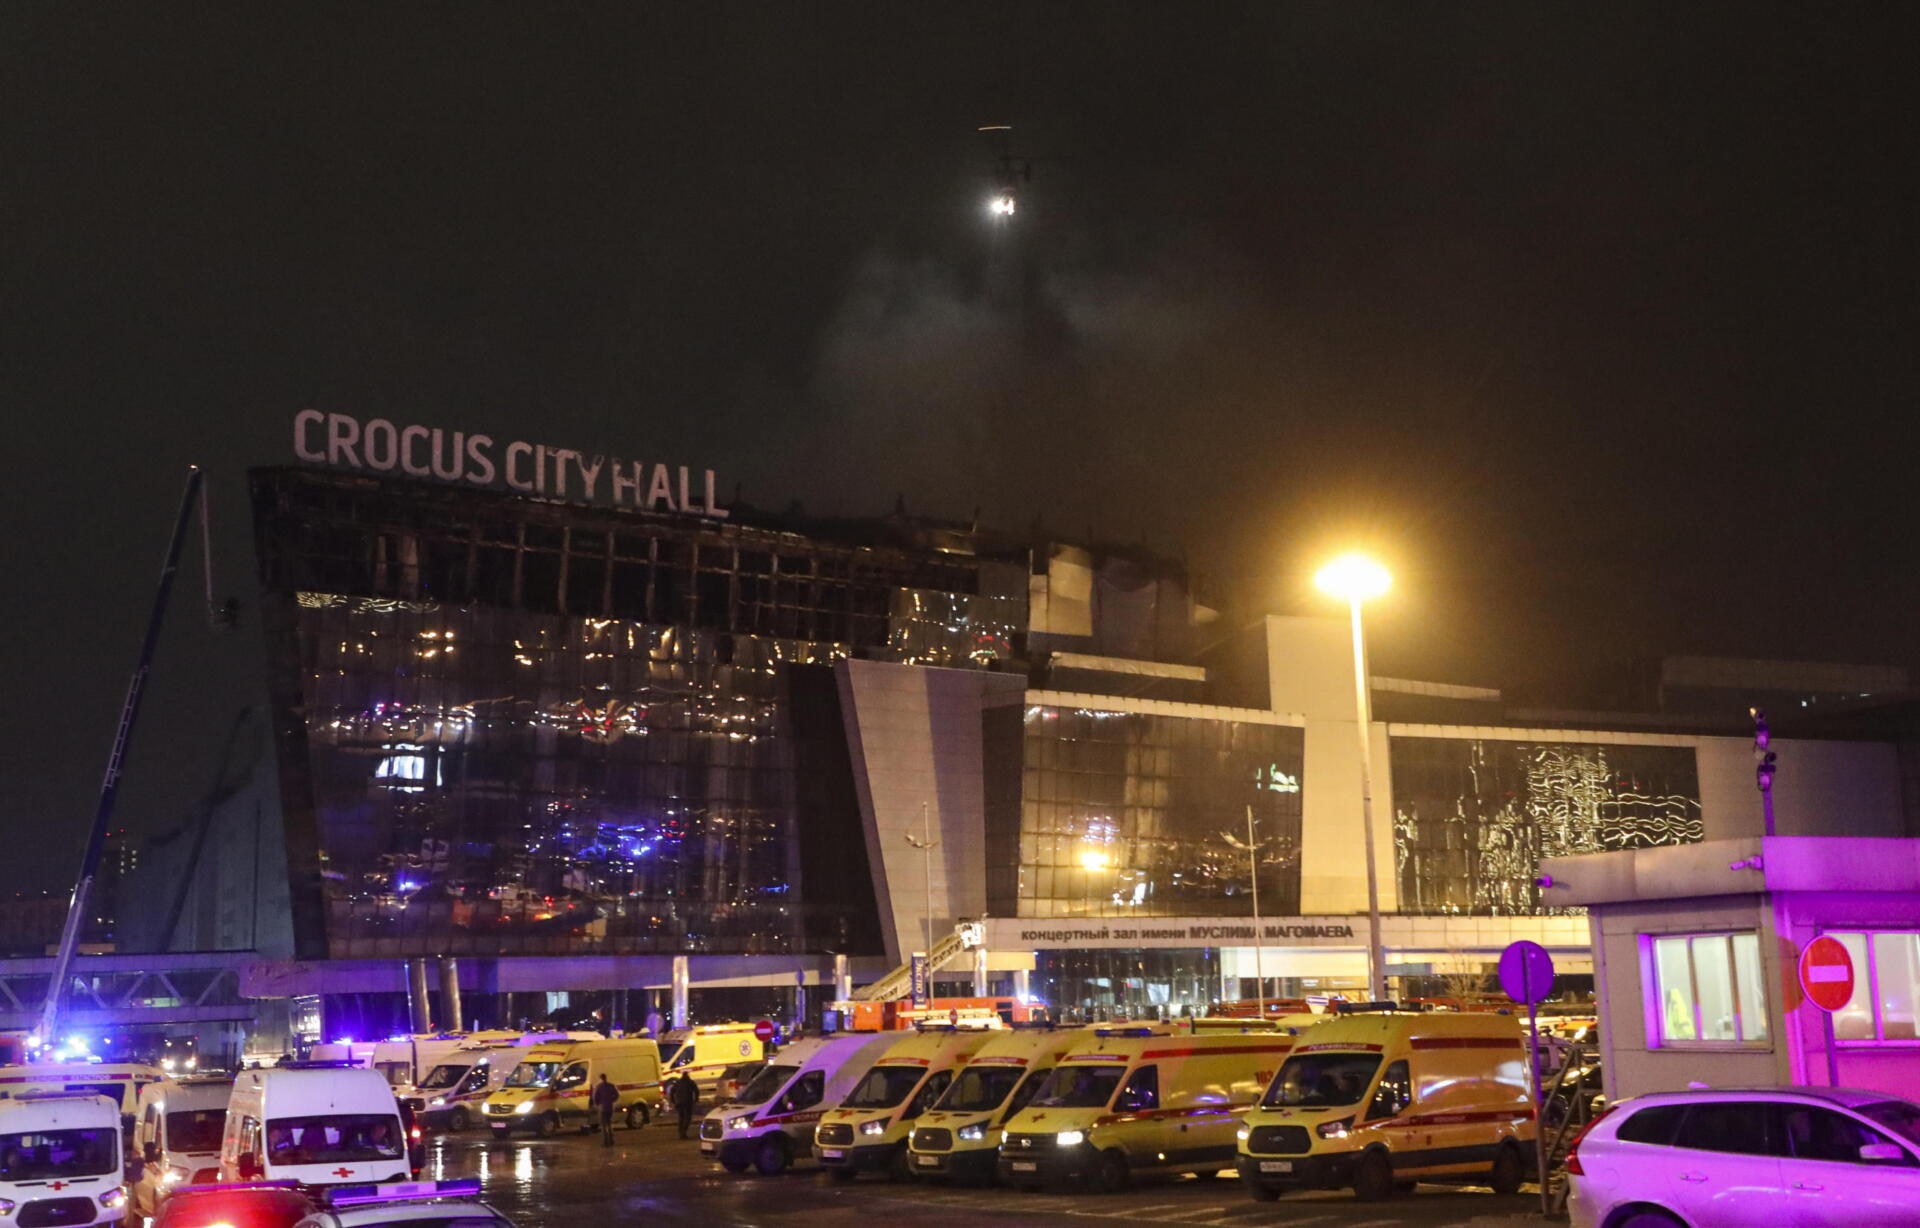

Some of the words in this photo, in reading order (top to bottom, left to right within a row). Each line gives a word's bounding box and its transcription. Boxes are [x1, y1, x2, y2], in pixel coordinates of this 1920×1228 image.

[294, 408, 496, 484] CROCUS
[505, 441, 604, 499] CITY
[612, 457, 730, 518] HALL
[1021, 926, 1109, 943] концертный
[1113, 928, 1137, 939] зал
[1142, 927, 1186, 939] имени
[1190, 925, 1261, 939] МУСЛИМА
[1265, 925, 1354, 939] МАГОМАЕВА
